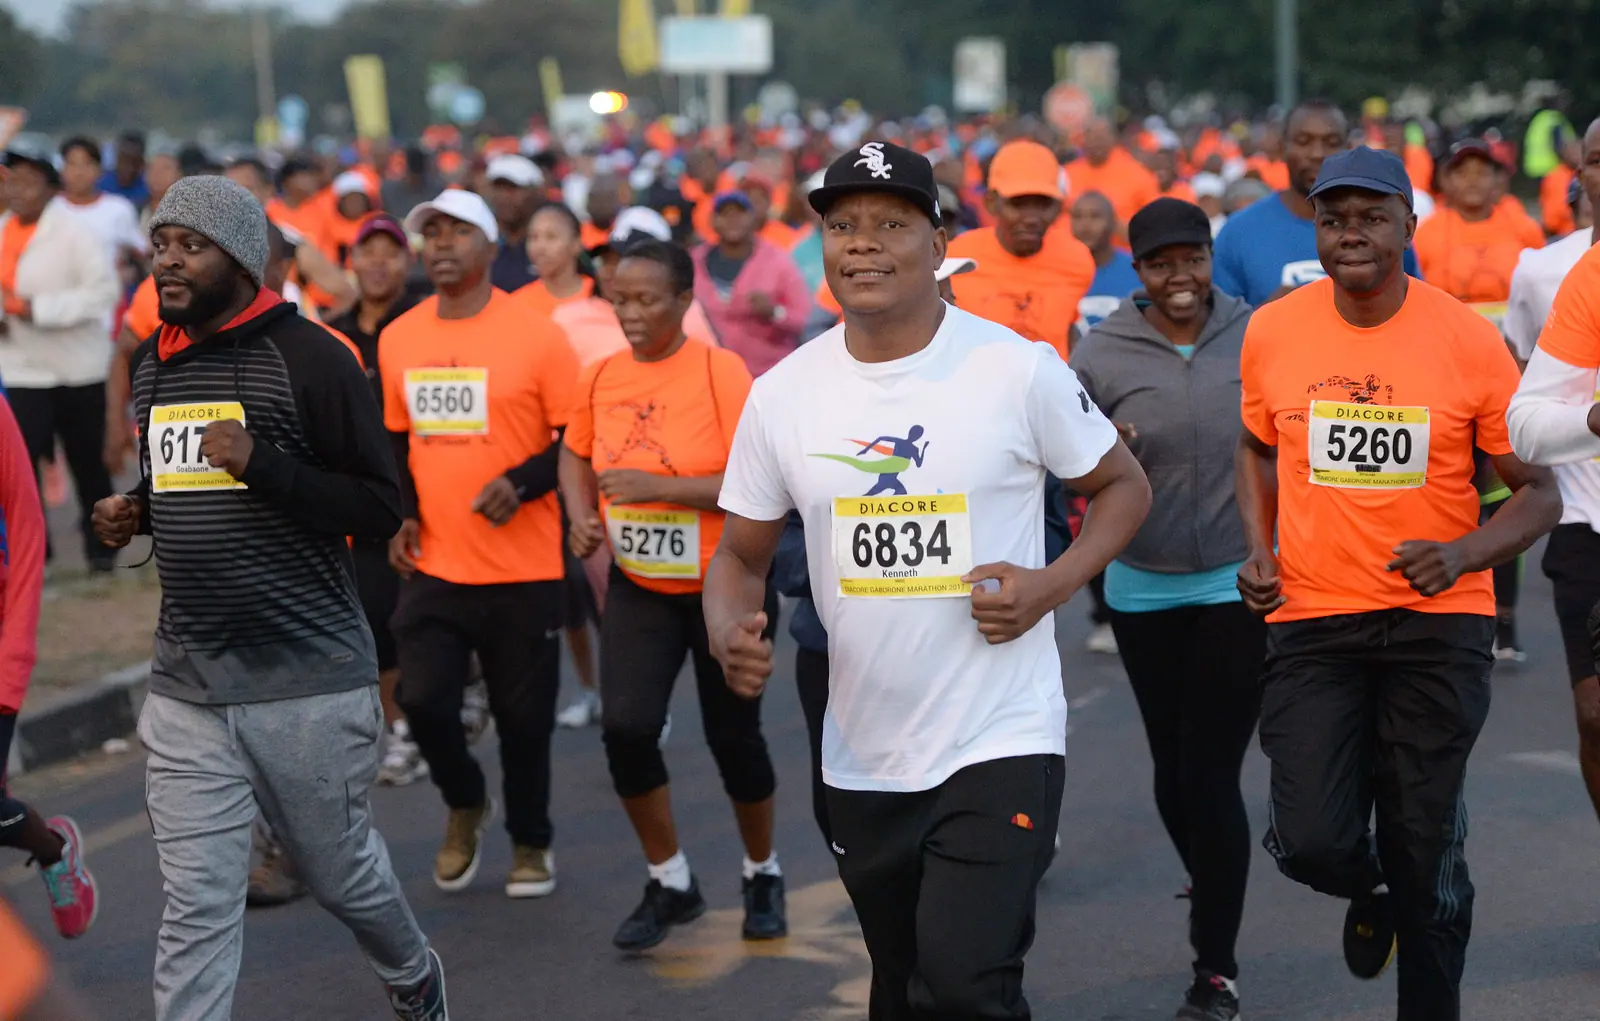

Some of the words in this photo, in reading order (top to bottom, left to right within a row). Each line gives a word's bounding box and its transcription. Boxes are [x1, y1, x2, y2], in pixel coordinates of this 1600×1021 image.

[416, 386, 473, 413] 6560
[168, 408, 221, 420] DIACORE
[1336, 408, 1404, 422] DIACORE
[160, 426, 206, 465] 617
[1327, 424, 1412, 465] 5260
[860, 500, 938, 515] DIACORE
[621, 526, 684, 556] 5276
[852, 519, 952, 568] 6834
[882, 568, 918, 578] Kenneth
[844, 586, 869, 594] DIACORE
[870, 586, 905, 594] GABORONE
[907, 585, 947, 593] MARATHON
[948, 583, 965, 591] 2017
